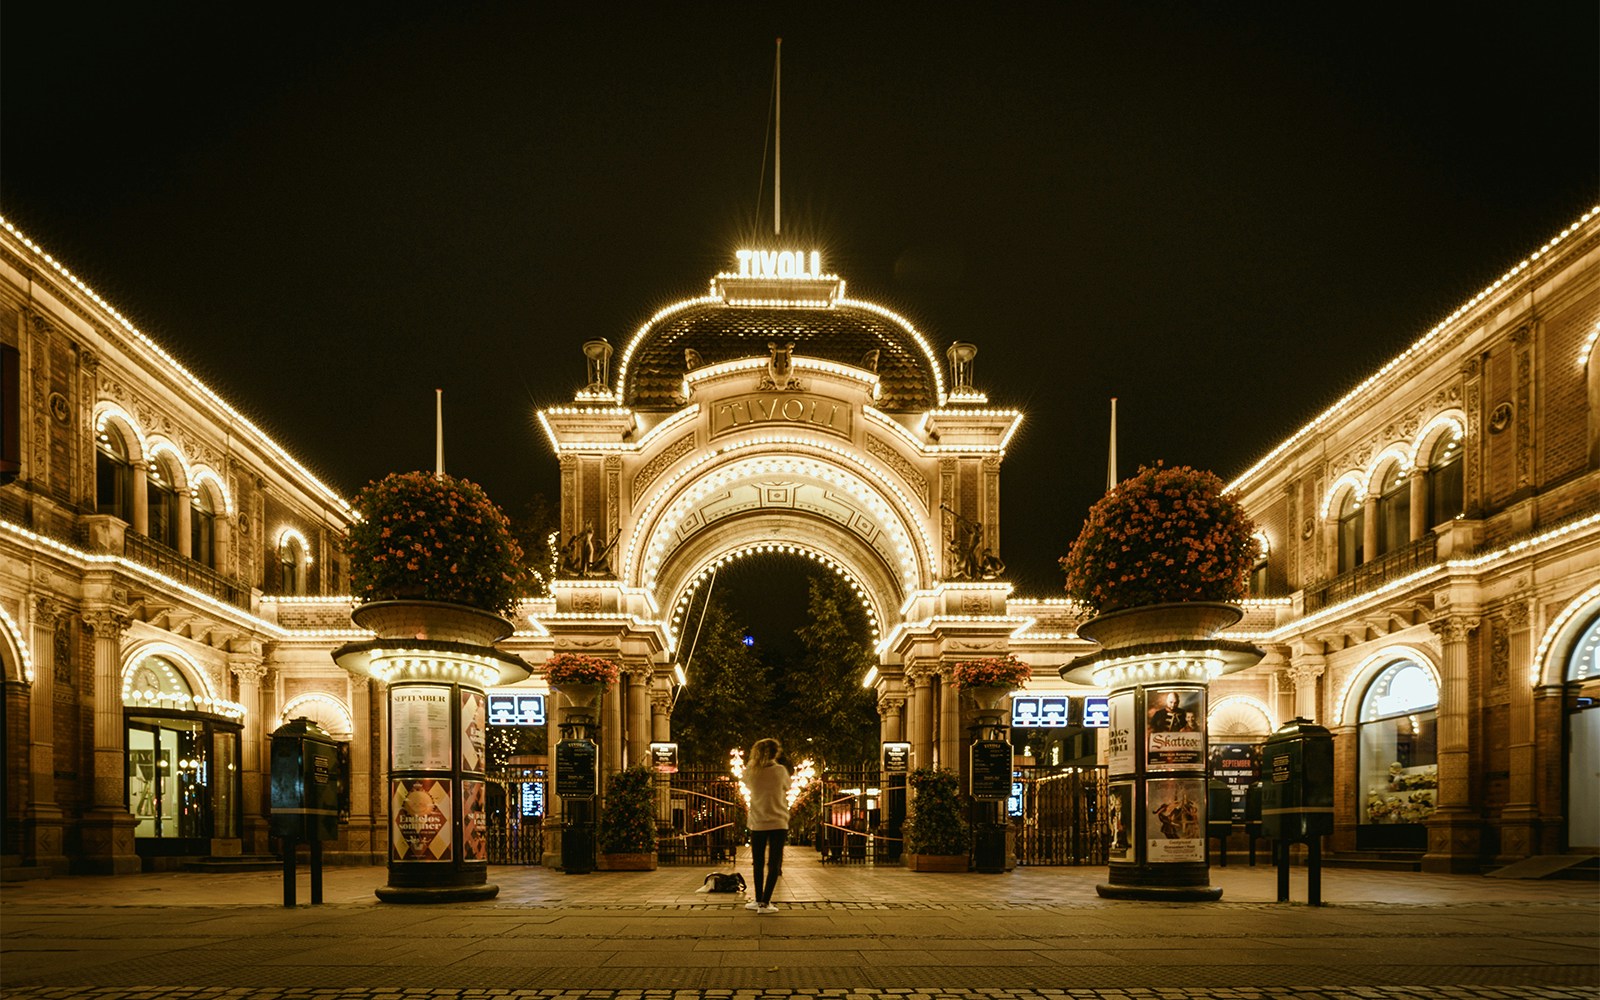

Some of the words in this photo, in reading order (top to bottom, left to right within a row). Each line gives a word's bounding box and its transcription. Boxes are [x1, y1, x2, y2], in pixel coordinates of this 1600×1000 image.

[736, 250, 820, 279] TIVOLI
[721, 399, 838, 426] TIVOLI
[1222, 760, 1251, 768] SEPTEMBER
